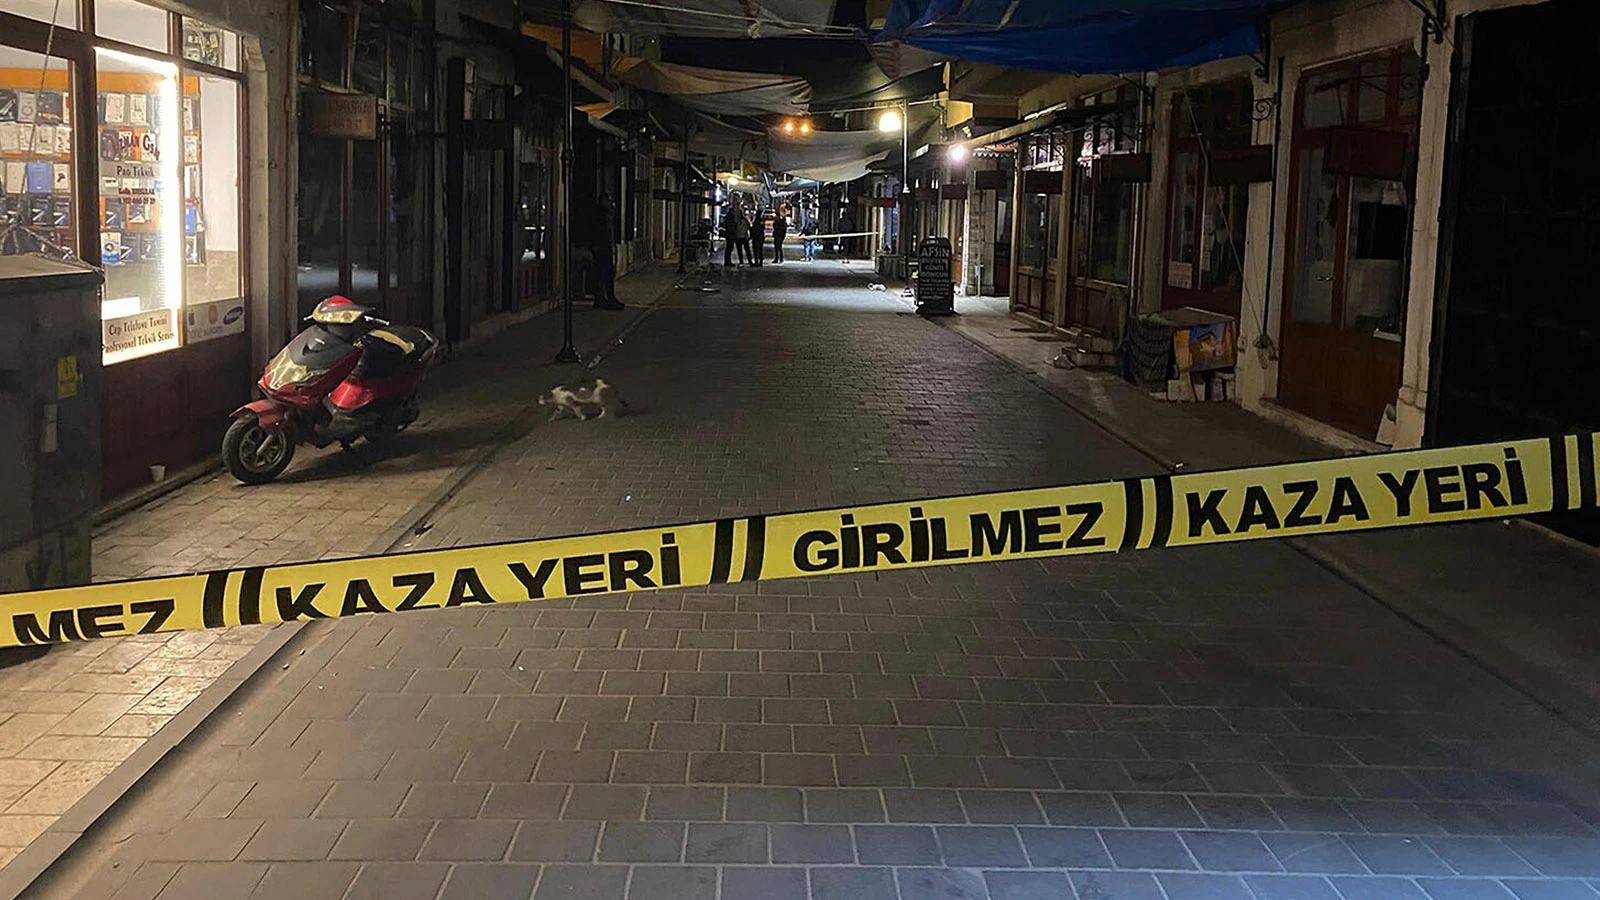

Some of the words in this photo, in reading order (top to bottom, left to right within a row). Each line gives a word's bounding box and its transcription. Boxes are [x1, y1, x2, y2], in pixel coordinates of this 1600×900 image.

[275, 568, 497, 621] KAZA
[507, 532, 681, 600] YERİ
[793, 501, 1107, 572] GİRİLMEZ
[1185, 477, 1370, 538] KAZA
[1377, 447, 1528, 517] YERİ
